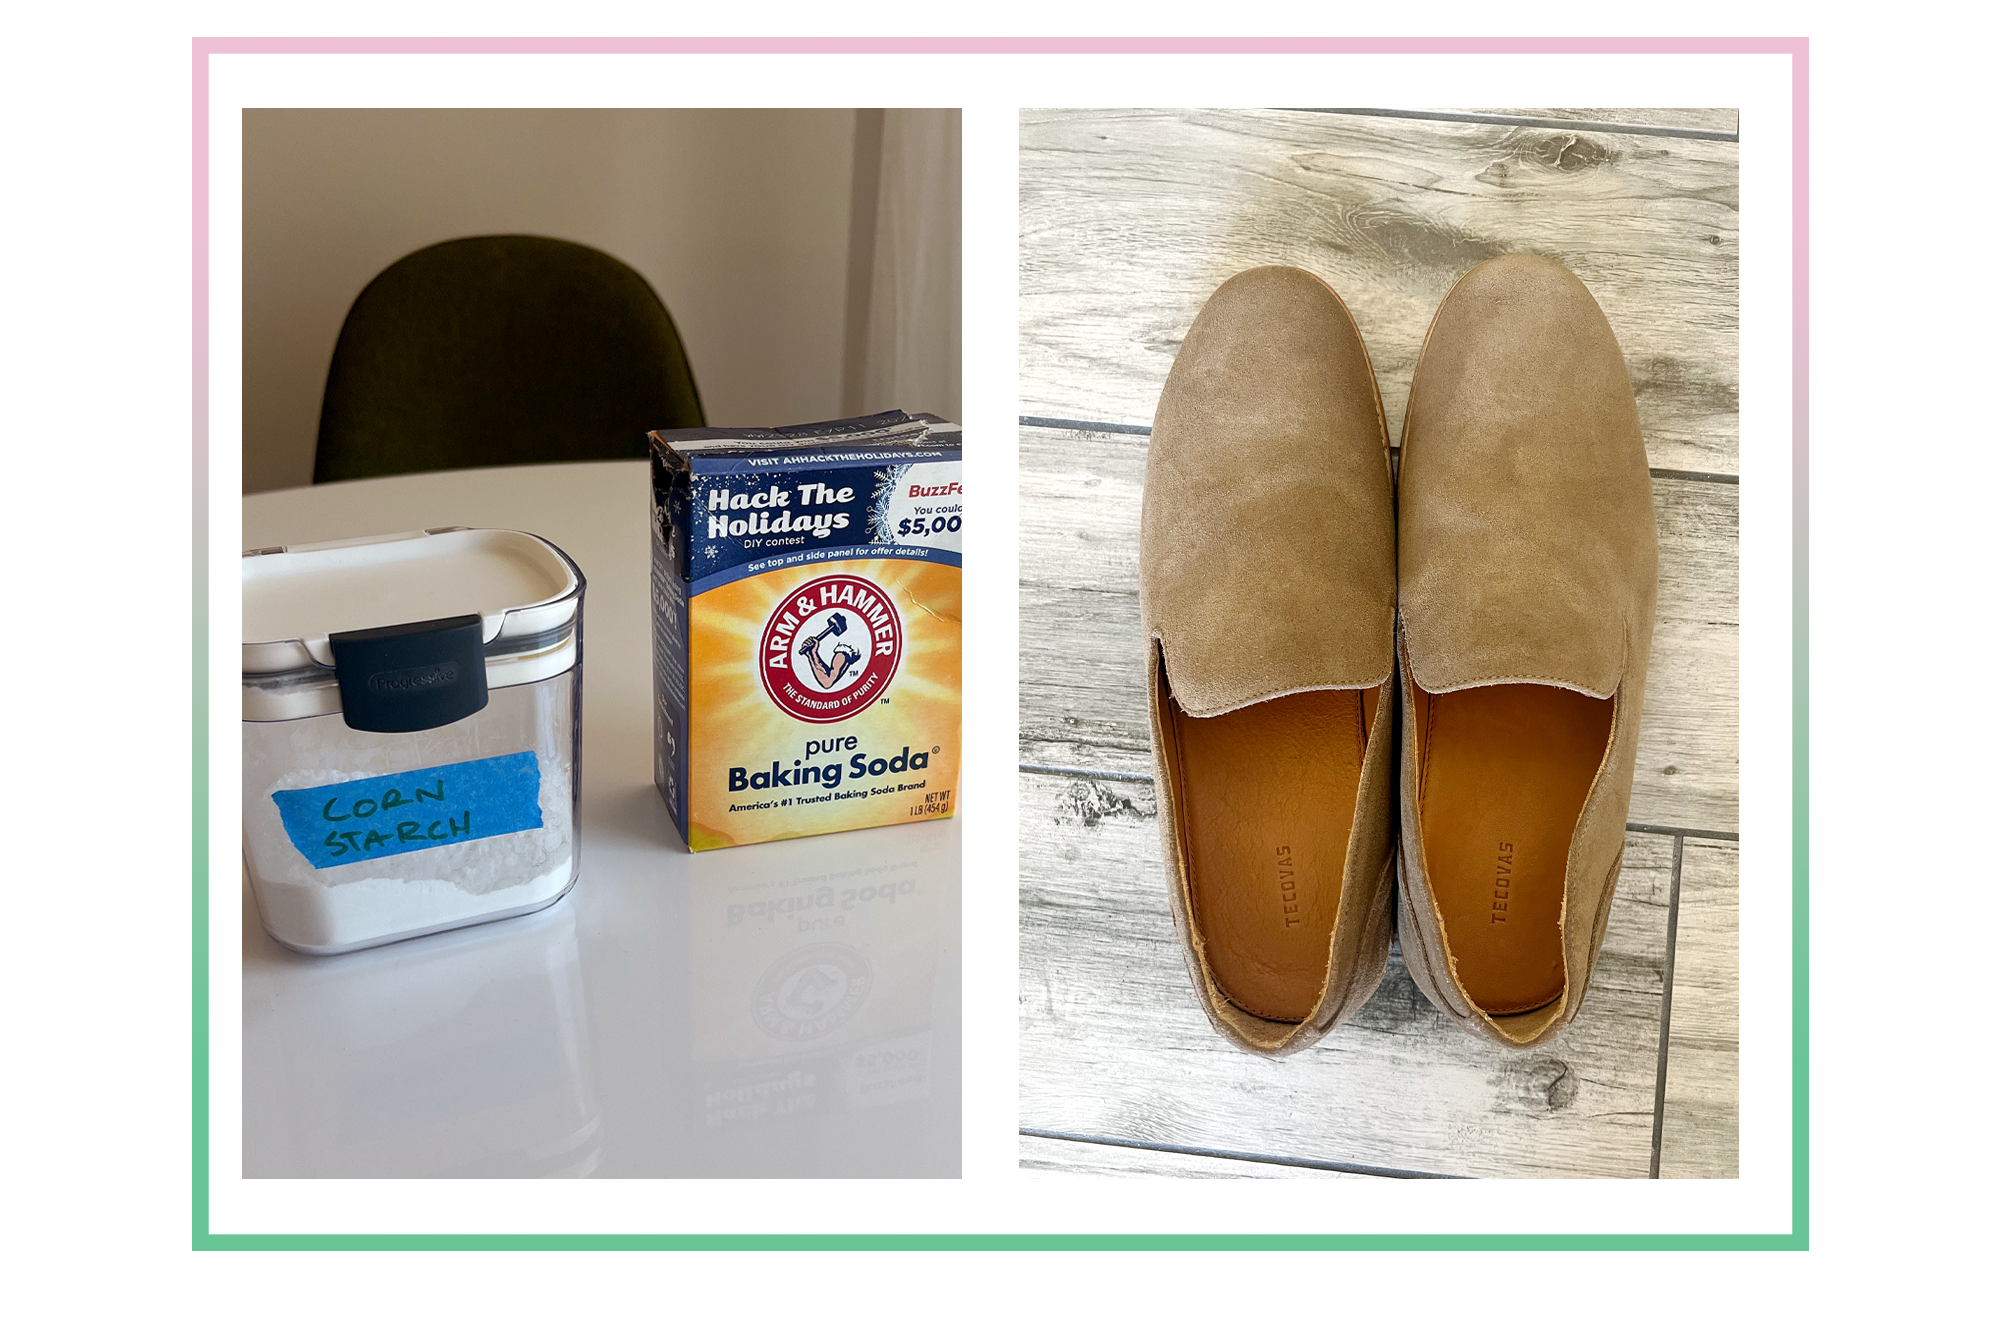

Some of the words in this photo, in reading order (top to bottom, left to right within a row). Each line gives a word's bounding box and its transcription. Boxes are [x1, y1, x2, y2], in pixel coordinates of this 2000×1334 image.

[748, 458, 779, 467] VISIT
[782, 451, 942, 465] AHHACKTHEHOLIDAYS.COM
[708, 485, 793, 511] Hack
[797, 482, 855, 505] The
[909, 482, 964, 498] BuzzFe
[914, 506, 933, 515] You
[935, 503, 964, 514] could
[708, 510, 850, 539] Holidays
[897, 515, 964, 537] $5,00
[744, 537, 763, 549] DIY
[765, 535, 805, 548] contest
[748, 562, 765, 572] See
[768, 559, 784, 569] top
[786, 554, 804, 563] and
[806, 551, 825, 561] side
[827, 549, 853, 560] panel
[855, 547, 869, 556] for
[870, 547, 894, 556] offer
[895, 547, 929, 558] details!
[769, 611, 800, 669] ARM
[796, 596, 818, 617] &
[819, 584, 894, 657] HAMMER
[377, 667, 454, 690] Progressive
[782, 682, 798, 699] THE
[795, 695, 840, 710] STANDARD
[842, 695, 853, 706] OF
[854, 672, 879, 700] PURITY
[805, 735, 858, 760] pure
[728, 760, 842, 792] Baking
[848, 747, 929, 779] Soda
[322, 779, 444, 822] CORN
[729, 801, 779, 812] America's
[781, 798, 793, 806] #1
[796, 793, 832, 805] Trusted
[834, 789, 868, 801] Baking
[870, 785, 895, 796] Soda
[897, 780, 926, 792] Brand
[915, 805, 923, 816] LB
[923, 802, 939, 815] (454
[939, 800, 949, 813] g)
[925, 792, 939, 803] NET
[939, 790, 951, 801] WT
[323, 811, 471, 857] STARCH
[1276, 844, 1300, 929] TECOVAS
[1491, 841, 1514, 925] TECOVAS
